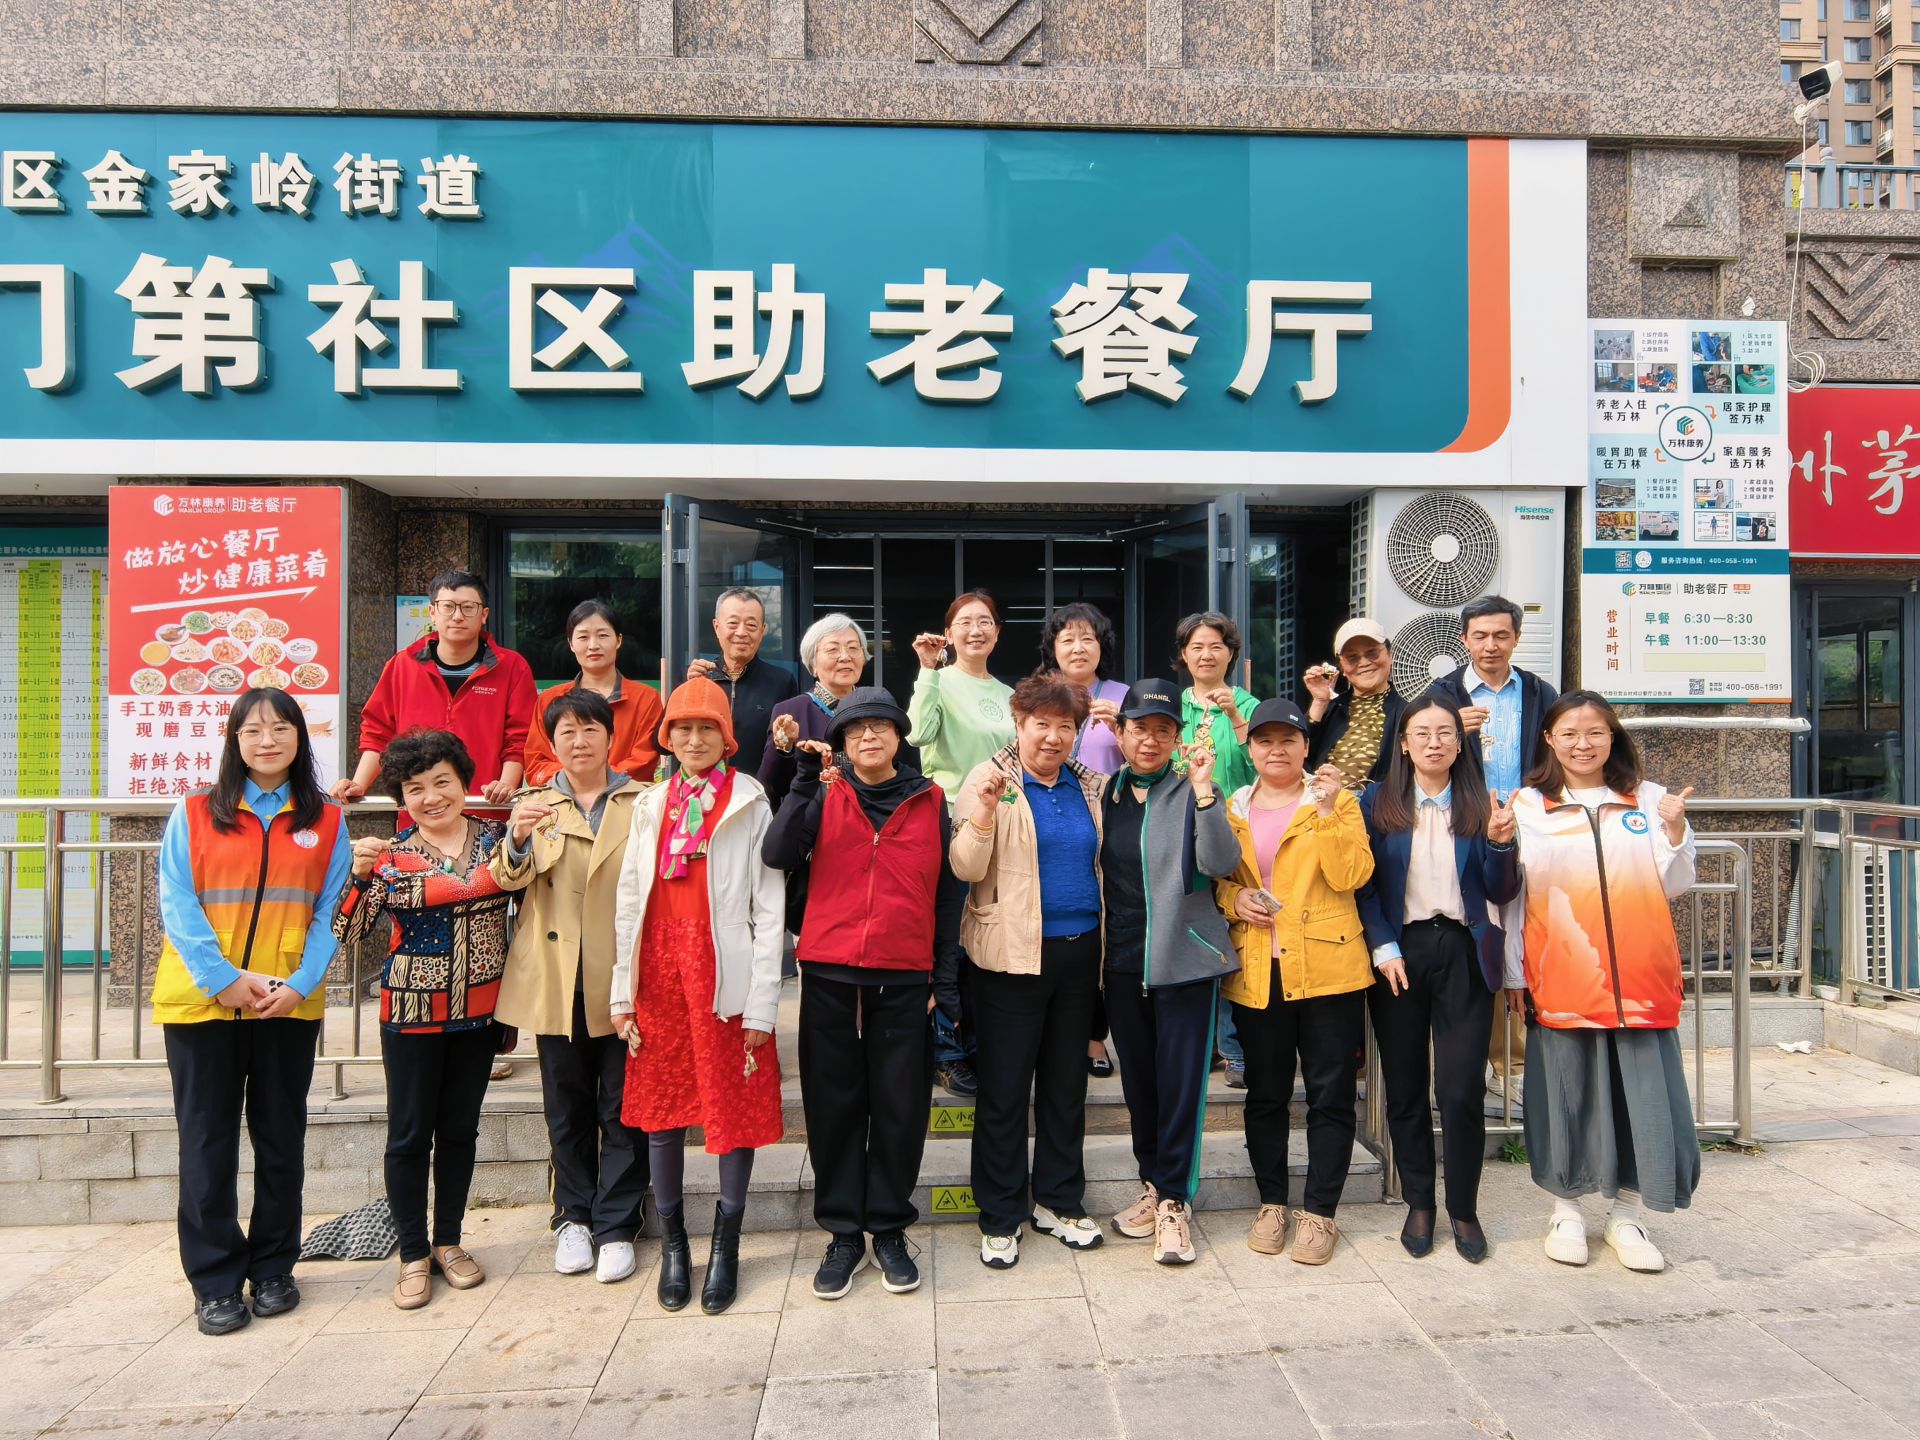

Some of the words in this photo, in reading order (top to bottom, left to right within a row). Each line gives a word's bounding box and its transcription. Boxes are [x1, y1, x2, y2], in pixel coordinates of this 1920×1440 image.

[2, 149, 484, 219] 区金家岭街道
[1596, 399, 1648, 410] 养老入住
[1723, 402, 1772, 413] 居家护理
[1603, 411, 1641, 422] 来万林
[1729, 413, 1765, 424] 签万林
[1668, 439, 1704, 448] 万林康养
[1596, 447, 1648, 458] 暖胃助餐
[1723, 446, 1772, 457] 家庭服务
[1603, 458, 1642, 470] 在万林
[1729, 458, 1766, 469] 选万林
[178, 497, 225, 507] 万林康养
[231, 497, 297, 513] 助老餐厅
[1514, 505, 1554, 514] Hisense
[124, 526, 281, 570] 做放心餐厅
[177, 549, 329, 596] 炒健康菜肴
[1683, 583, 1728, 595] 助老餐厅
[1644, 612, 1670, 624] 早餐
[1606, 609, 1620, 671] 营业时间
[1644, 634, 1670, 646] 午餐
[1726, 683, 1783, 691] 400-058-1991
[120, 700, 231, 717] 手工奶香大油
[129, 751, 213, 771] 新鲜食材
